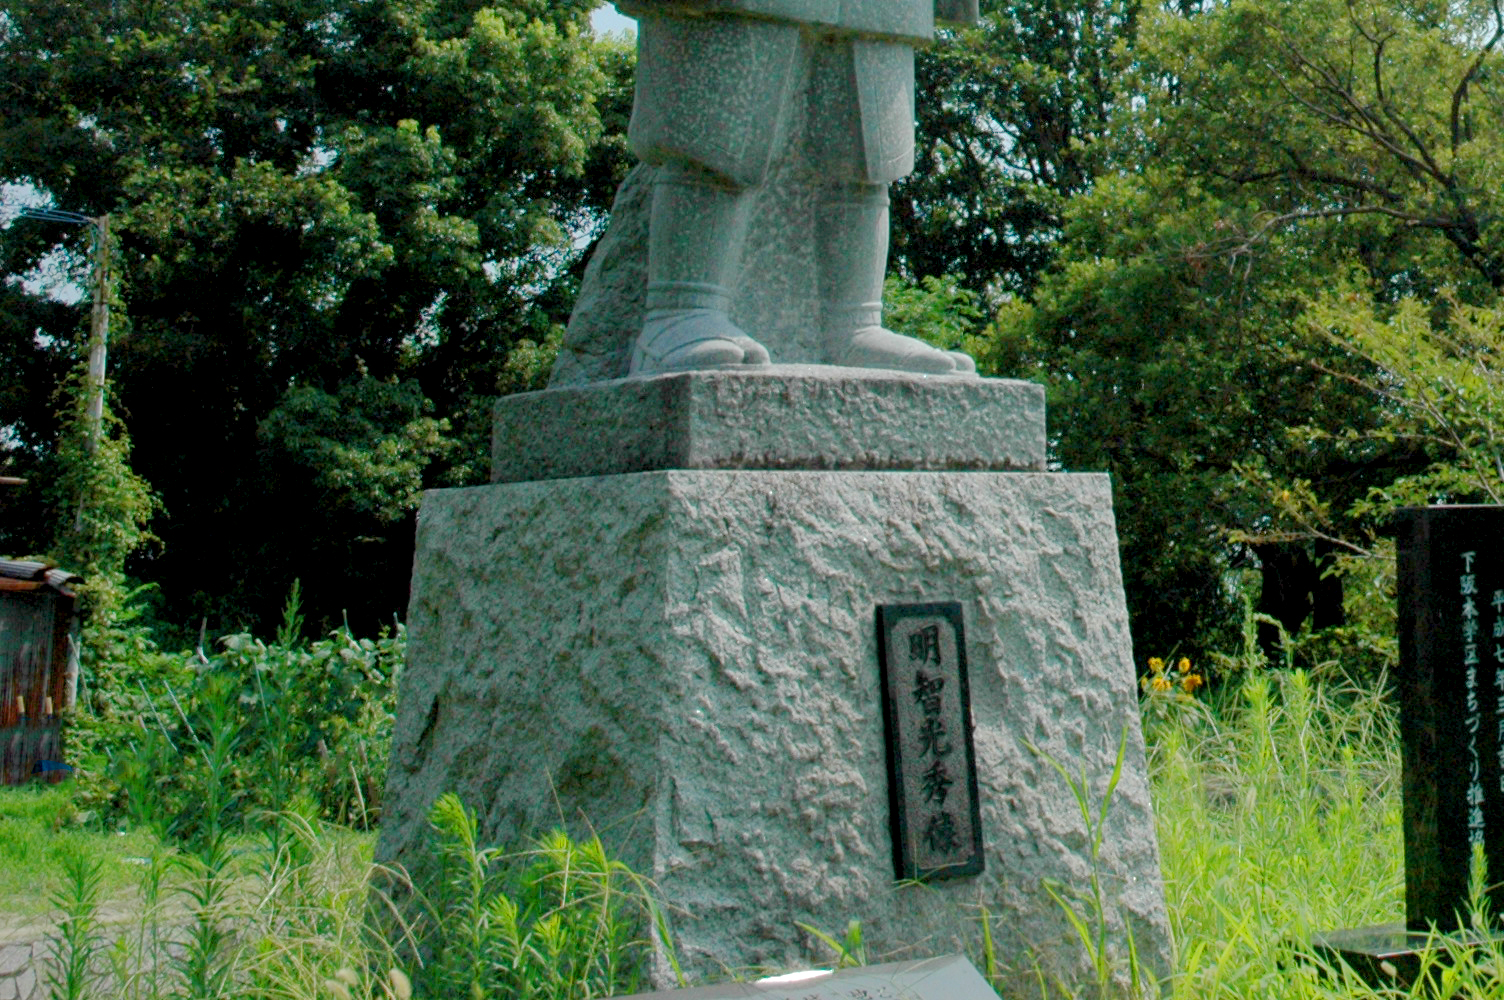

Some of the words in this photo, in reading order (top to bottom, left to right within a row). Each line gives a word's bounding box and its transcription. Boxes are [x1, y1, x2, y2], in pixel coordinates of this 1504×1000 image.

[908, 624, 960, 854] 明智光秀像
